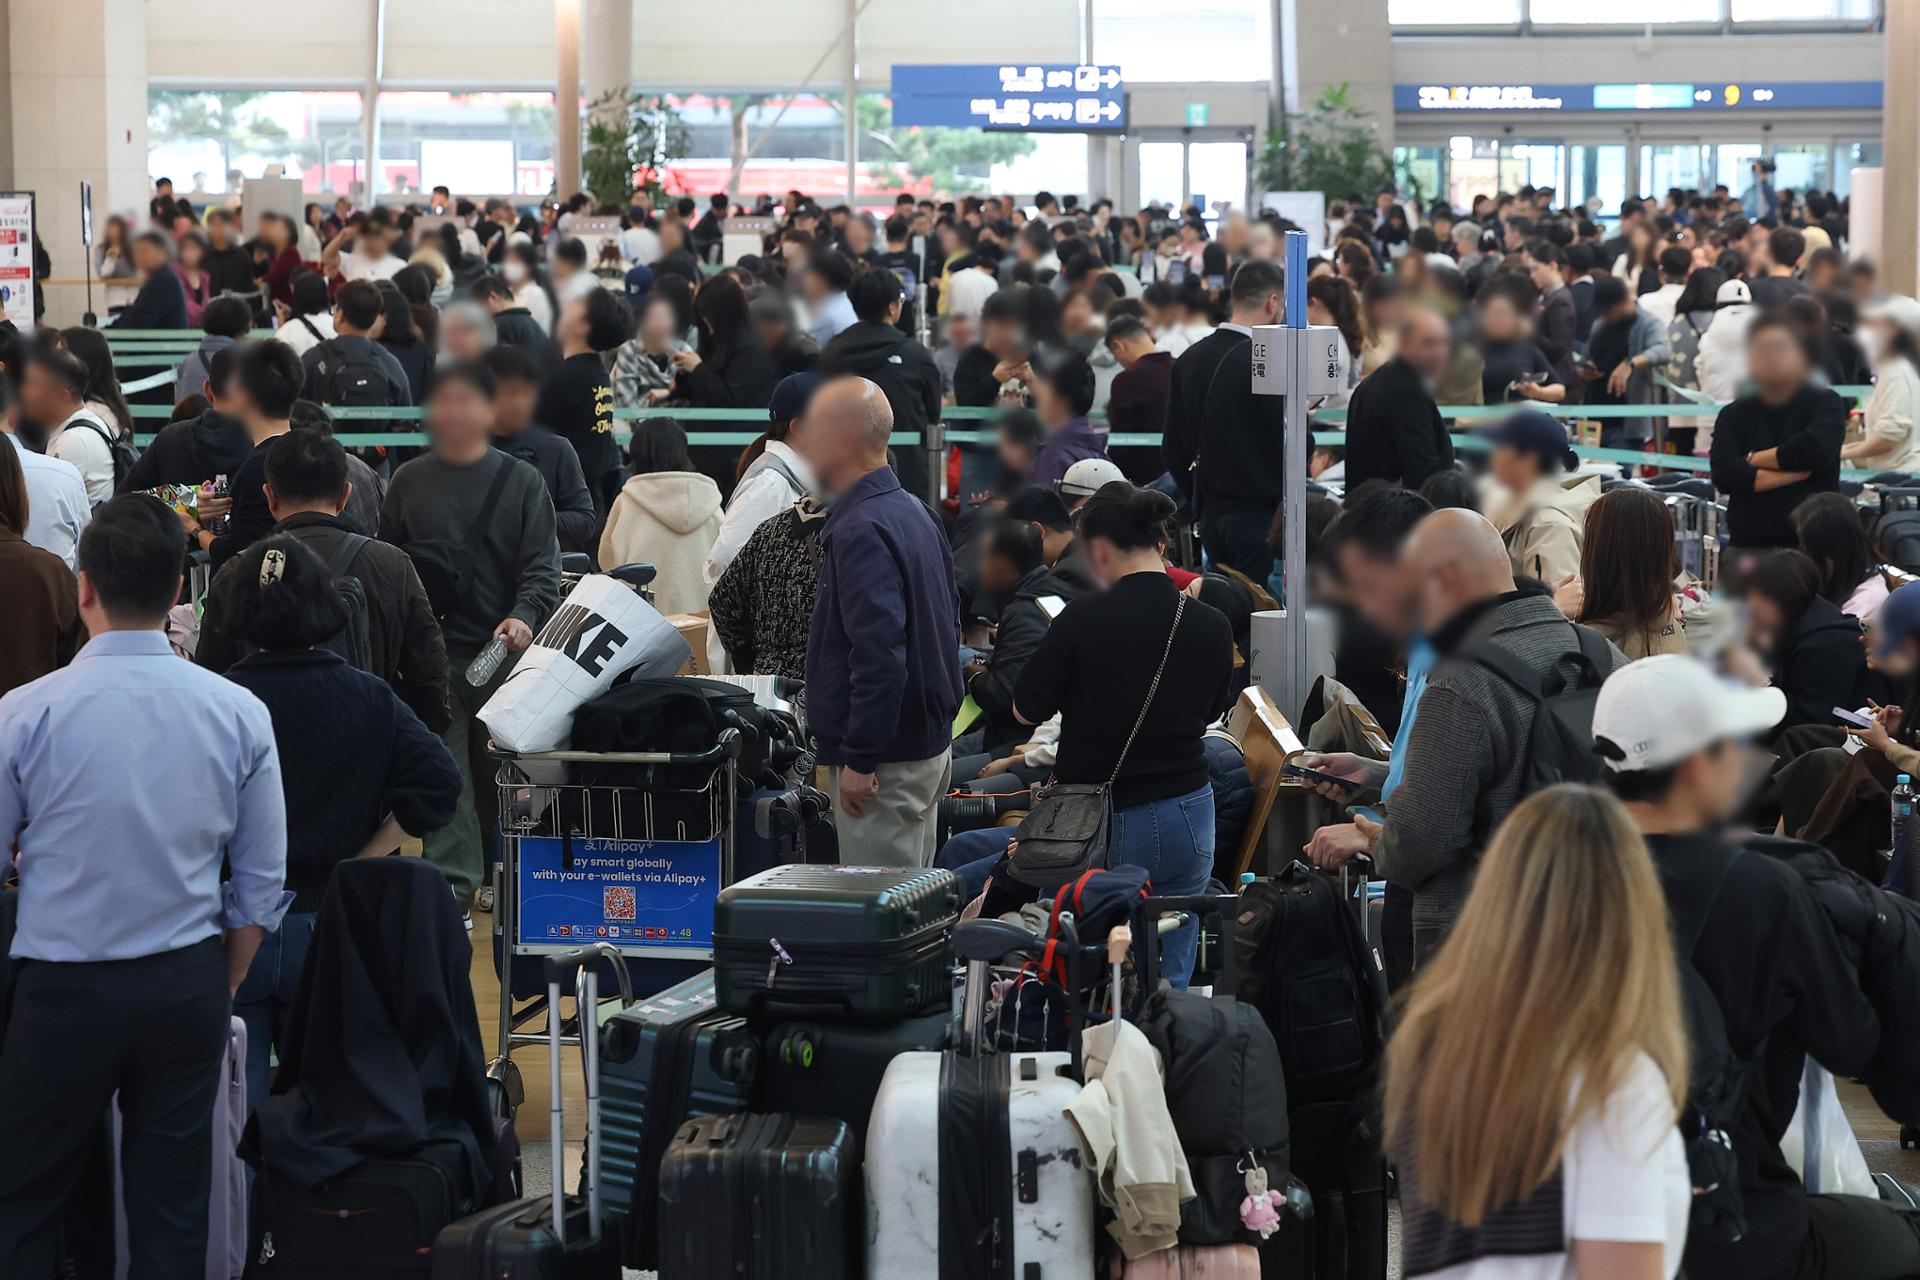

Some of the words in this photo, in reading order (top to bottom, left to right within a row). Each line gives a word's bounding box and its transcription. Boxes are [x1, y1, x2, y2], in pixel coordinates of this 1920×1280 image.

[1725, 85, 1740, 105] 9
[573, 858, 588, 868] ay
[590, 858, 624, 867] smart
[627, 858, 672, 871] globally
[533, 870, 557, 880] with
[560, 872, 585, 883] your
[588, 872, 641, 882] e-wallets
[644, 873, 661, 883] via
[664, 874, 706, 886] Alipay+
[680, 928, 692, 937] 48
